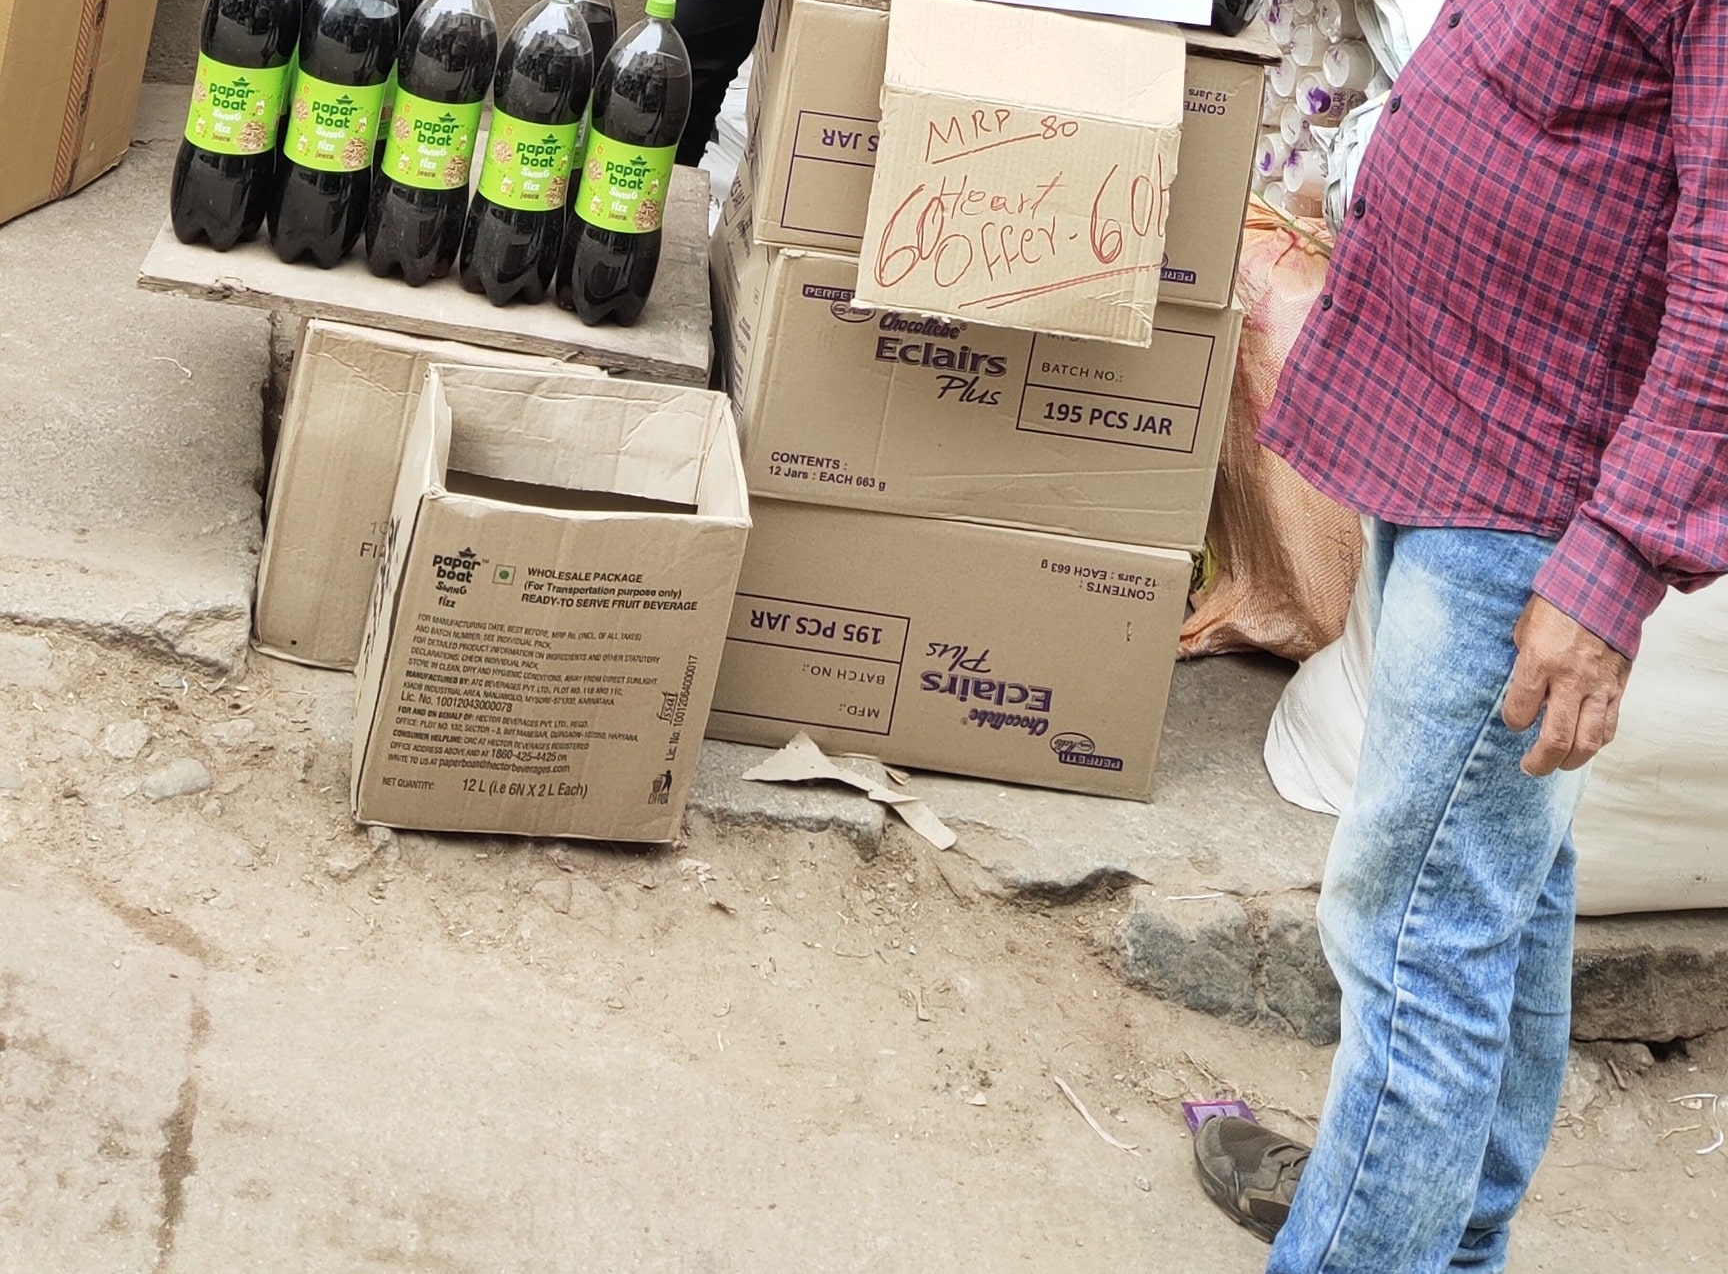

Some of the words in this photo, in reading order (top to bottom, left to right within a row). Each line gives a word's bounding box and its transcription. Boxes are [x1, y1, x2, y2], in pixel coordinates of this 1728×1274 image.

[209, 82, 254, 99] paper
[212, 96, 247, 111] boat
[312, 100, 358, 116] paper
[315, 114, 350, 129] boat
[414, 119, 459, 135] paper
[1042, 115, 1078, 140] 80
[417, 132, 452, 146] boat
[822, 126, 863, 149] JAR
[516, 142, 561, 158] paper
[520, 155, 554, 168] boat
[606, 161, 650, 178] paper
[609, 176, 644, 190] boat
[875, 336, 1008, 378] Eclairs
[1041, 362, 1089, 380] BATCH
[935, 373, 1003, 408] Plus
[1043, 401, 1083, 425] 195
[1088, 408, 1129, 431] PCS
[1133, 411, 1173, 437] JAR
[771, 451, 841, 471] CONTENTS
[768, 464, 782, 478] 12
[784, 467, 809, 482] Jars
[819, 471, 853, 486] EACH
[856, 475, 877, 489] 663
[432, 554, 481, 572] paper
[1050, 562, 1071, 575] 663
[436, 566, 473, 584] boat
[527, 567, 591, 582] WHOLESALE
[593, 570, 644, 584] PACKAGE
[1073, 567, 1107, 581] EACH
[1117, 572, 1142, 585] Jars
[1144, 575, 1158, 587] 12
[524, 580, 545, 592] (For
[546, 582, 616, 597] Transportation
[617, 587, 657, 599] purpose
[658, 587, 682, 600] only)
[1086, 582, 1155, 601] CONTENTS
[438, 595, 456, 608] fizz
[576, 597, 610, 610] SERVE
[611, 598, 641, 610] FRUIT
[643, 599, 698, 612] BEVERAGE
[750, 608, 790, 631] JAR
[796, 616, 836, 639] PCS
[843, 622, 882, 645] 195
[926, 642, 991, 673] Plus
[835, 669, 886, 686] BATCH
[419, 693, 433, 705] No.
[920, 670, 1055, 713] Eclairs
[1060, 753, 1122, 770] PERFETTI
[462, 778, 477, 792] 12
[478, 779, 486, 793] L
[508, 782, 526, 796] 6N
[526, 783, 537, 797] X
[537, 783, 547, 797] 2
[547, 783, 555, 797] L
[557, 782, 588, 799] Each)
